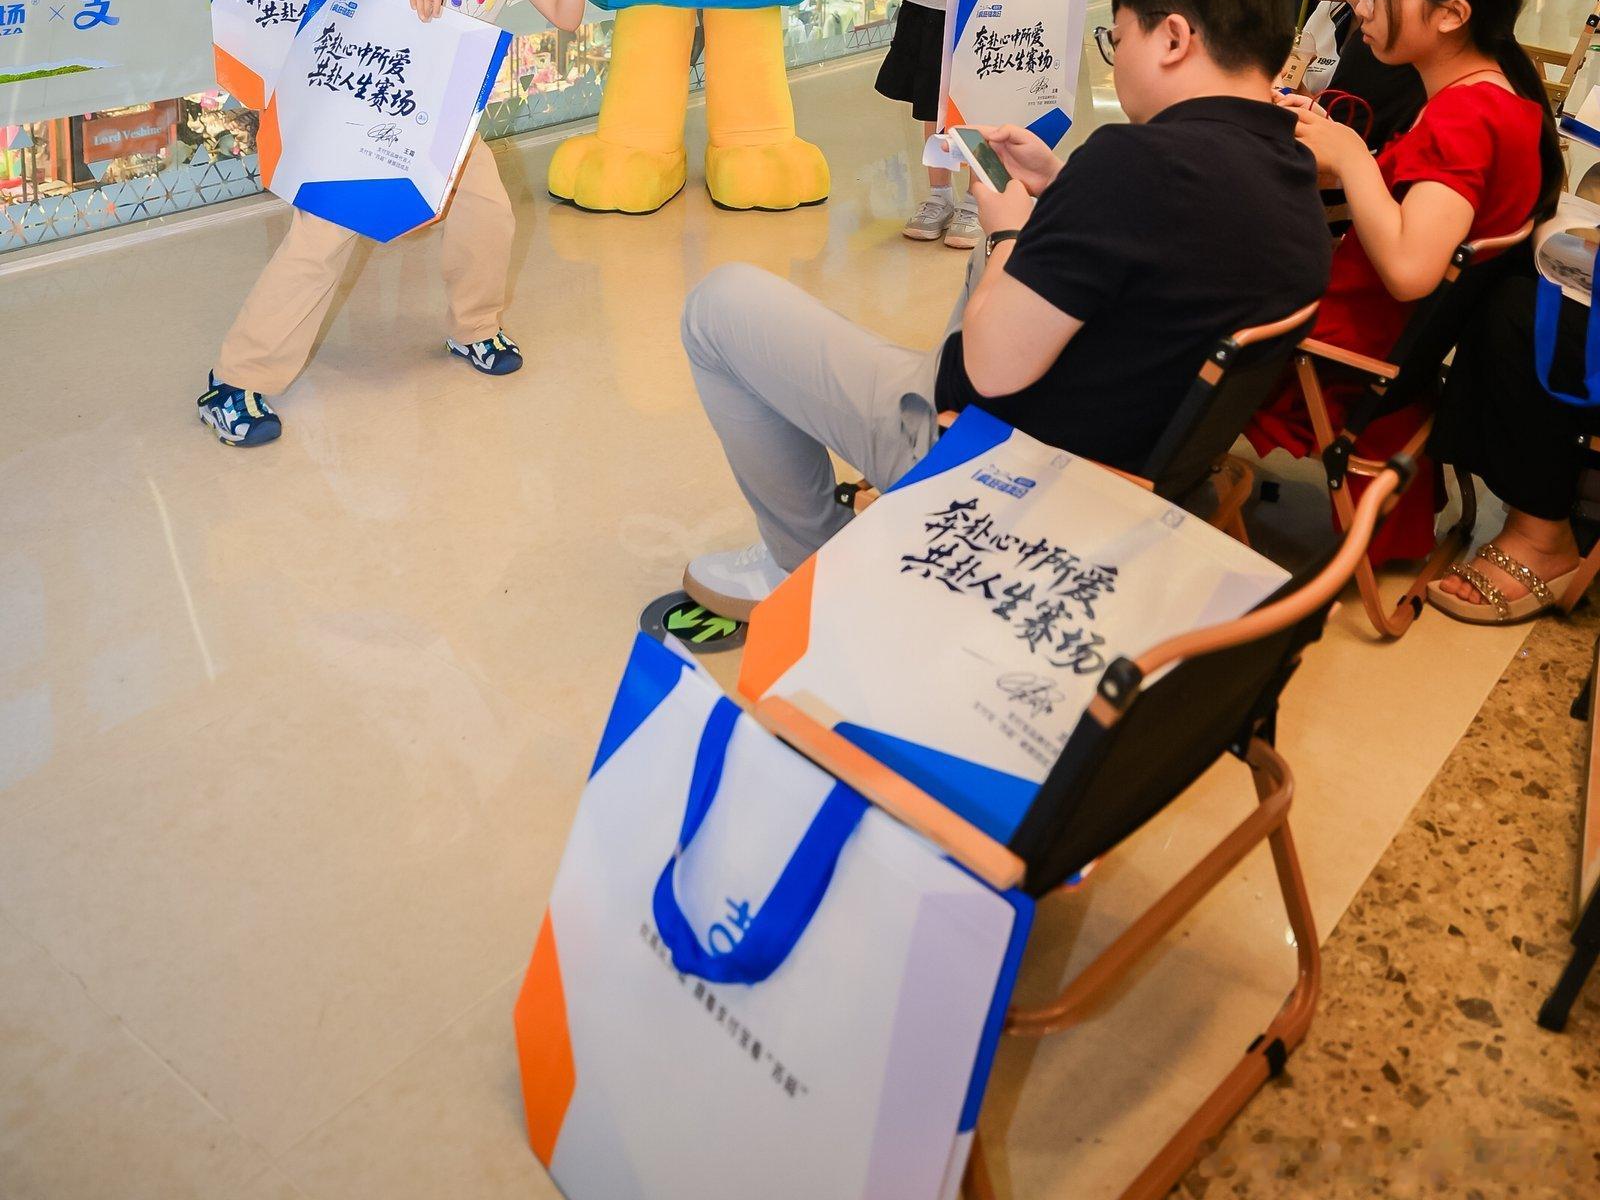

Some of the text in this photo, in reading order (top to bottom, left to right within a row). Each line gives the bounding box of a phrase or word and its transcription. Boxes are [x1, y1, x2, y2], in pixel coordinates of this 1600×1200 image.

[0, 27, 23, 37] ZA
[973, 20, 1045, 59] 奔赴心中所爱
[312, 22, 412, 84] 奔赴心中所爱
[976, 46, 1054, 80] 共赴人生赛场
[1317, 57, 1336, 66] 1997
[307, 56, 417, 117] 共赴人生赛场
[923, 497, 1120, 621] 奔赴心中所爱
